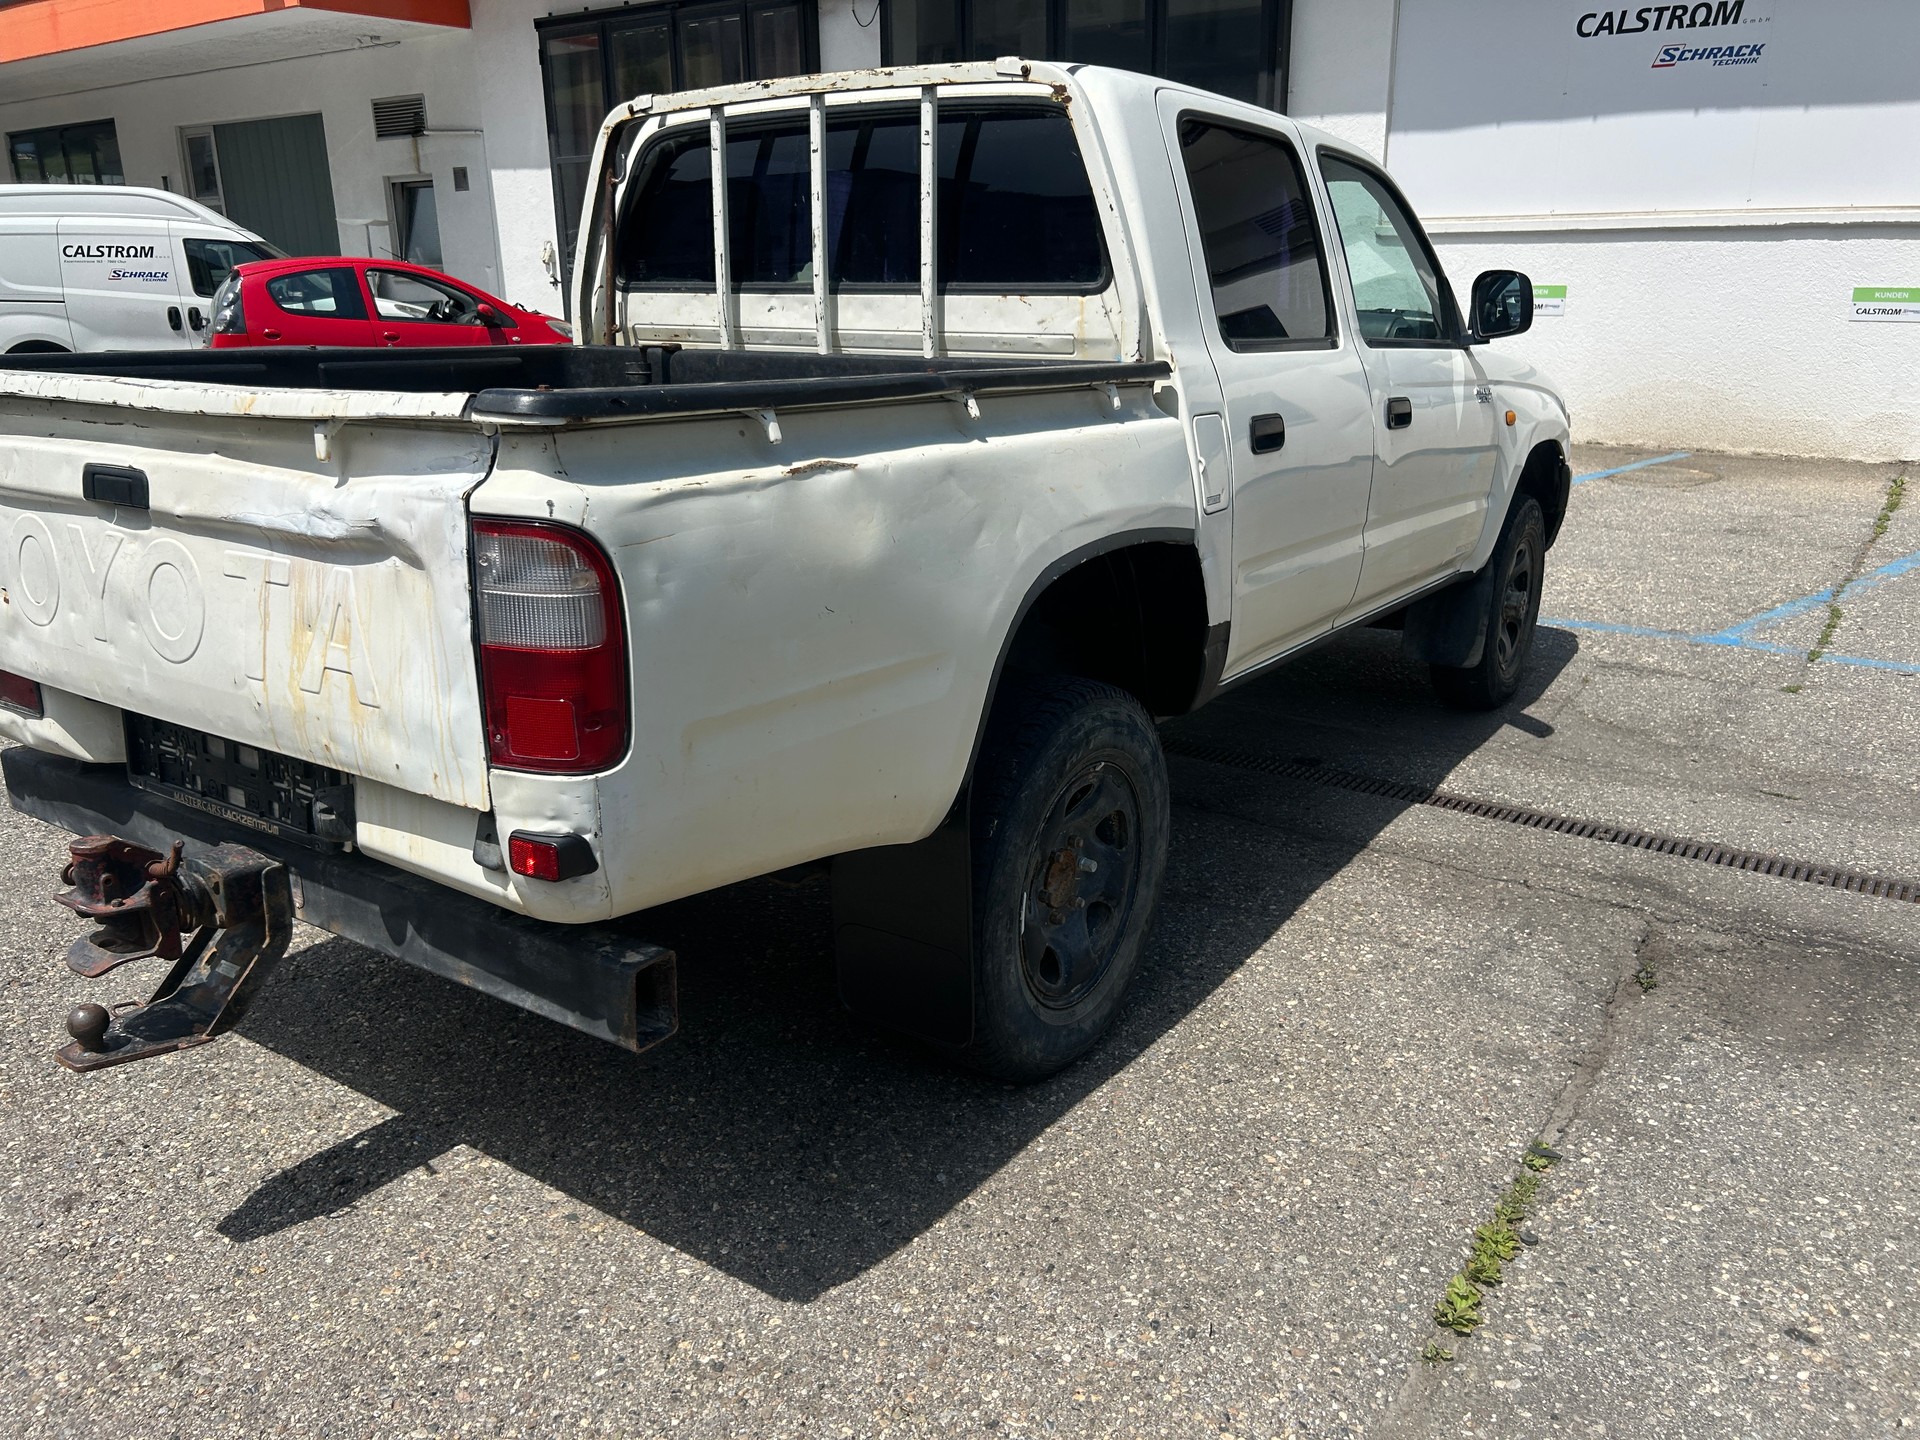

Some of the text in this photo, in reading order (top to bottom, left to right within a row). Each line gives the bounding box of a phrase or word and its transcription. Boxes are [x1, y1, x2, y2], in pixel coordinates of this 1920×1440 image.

[1658, 44, 1766, 63] SCHRACK
[1712, 57, 1759, 67] TECHNIK
[111, 269, 169, 278] SCHRACK
[8, 513, 381, 709] OYOTA
[173, 791, 279, 835] MASTERCARS LACKZENTRUM
